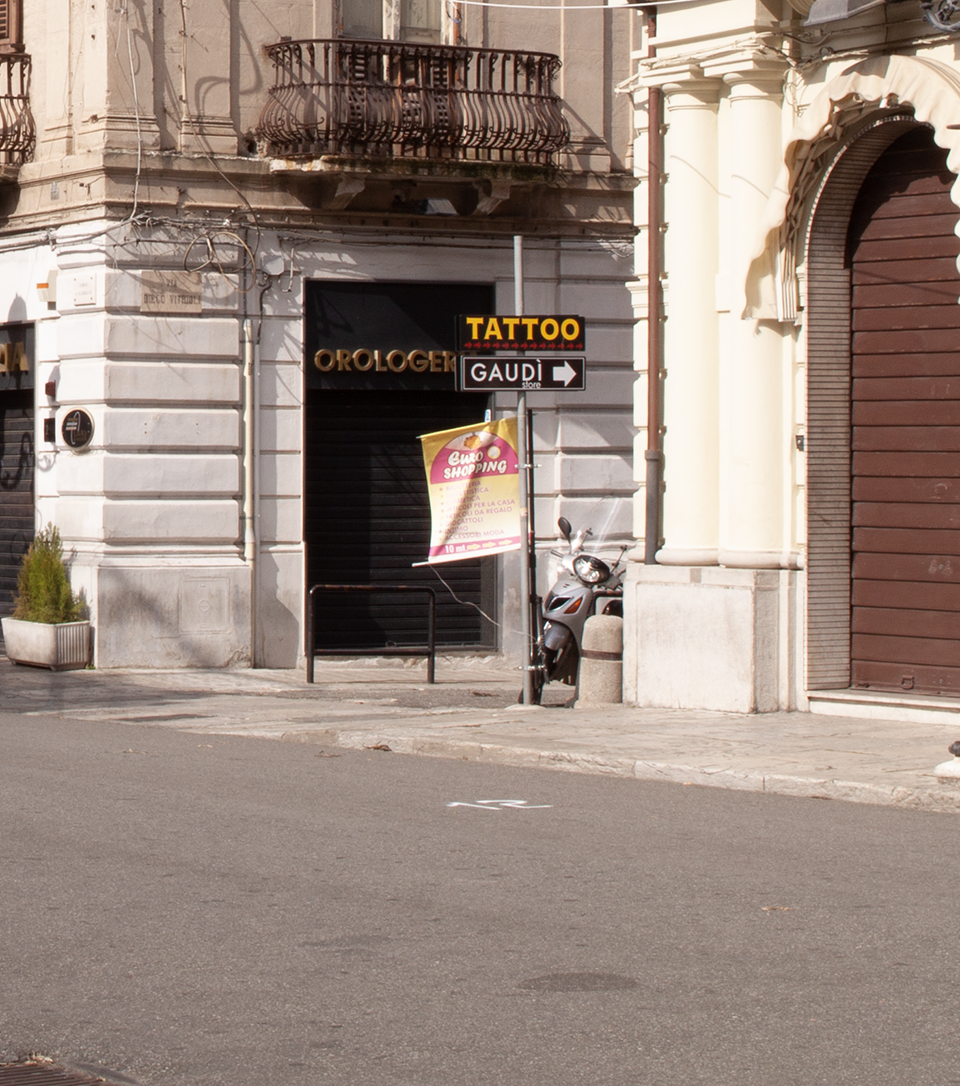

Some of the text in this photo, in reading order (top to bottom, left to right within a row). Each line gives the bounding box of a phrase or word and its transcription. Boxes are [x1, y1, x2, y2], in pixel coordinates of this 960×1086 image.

[466, 316, 580, 341] TATTOO
[314, 347, 478, 373] OROLOGER
[470, 358, 542, 382] GAUDÌ
[521, 381, 541, 389] store
[443, 459, 507, 479] SHOPPING
[486, 506, 513, 514] REGALO
[445, 517, 483, 527] GIOCATTOLI
[445, 525, 468, 534] INTIMO
[445, 531, 481, 540] ACCESSORI
[445, 544, 454, 553] 10
